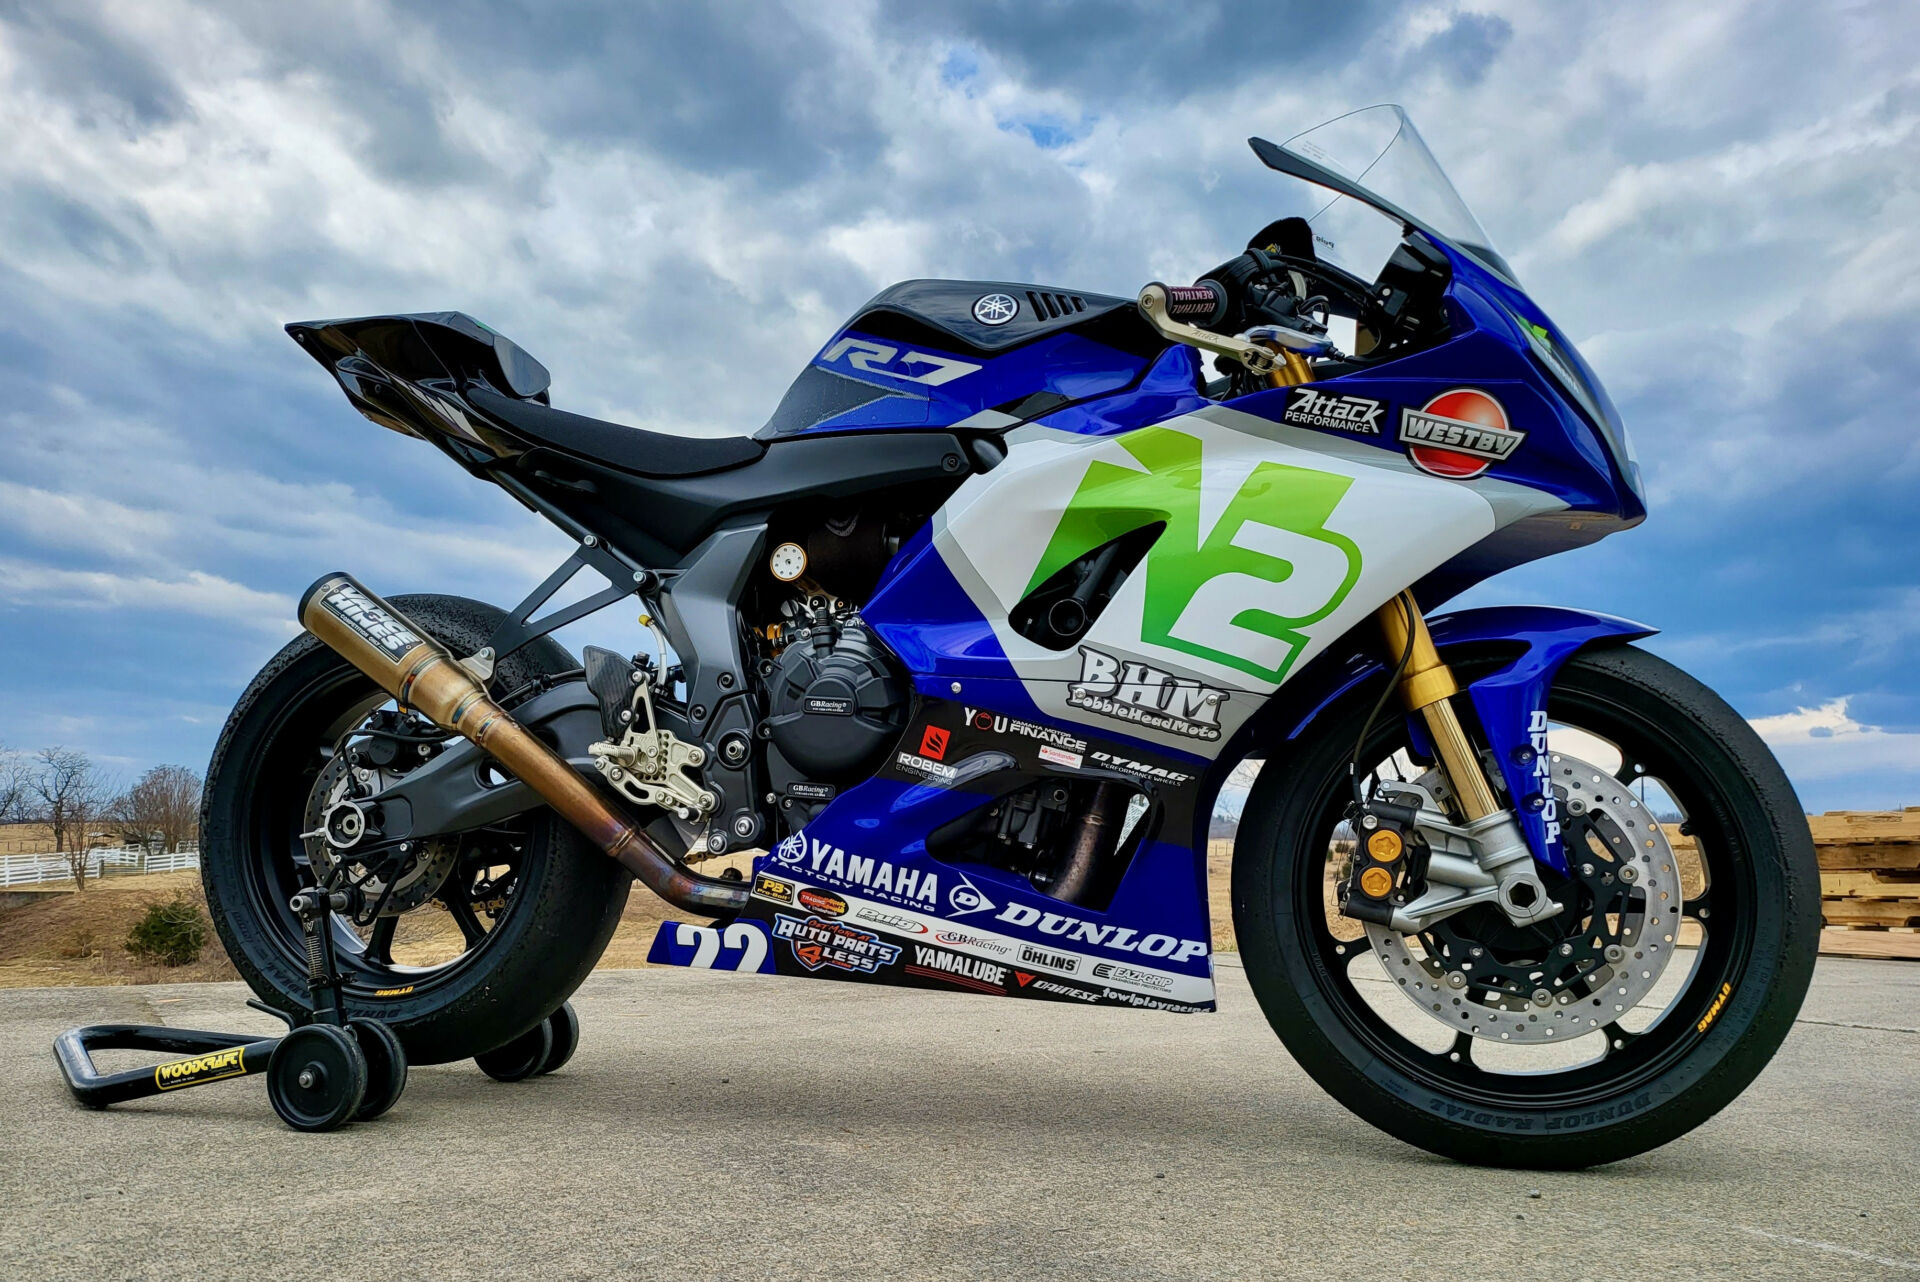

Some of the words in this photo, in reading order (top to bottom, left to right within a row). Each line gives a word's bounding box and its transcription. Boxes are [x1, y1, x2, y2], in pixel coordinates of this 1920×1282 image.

[1172, 290, 1214, 301] RENTHAL
[1172, 302, 1215, 314] RENTHAL
[822, 337, 983, 386] R7
[1285, 411, 1371, 433] PERFORMANCE
[1288, 388, 1384, 433] Attack
[1407, 417, 1514, 454] WESTBY
[327, 593, 405, 651] HINES
[340, 614, 369, 638] COMPETITION
[1071, 646, 1228, 725] BHM
[1009, 723, 1088, 751] FINANCE
[1012, 719, 1043, 731] YAMAHA
[1044, 727, 1072, 738] MOTOR
[895, 764, 953, 785] ENGINEERING
[900, 753, 956, 779] ROBEM
[1090, 751, 1189, 782] DYMAG
[1101, 762, 1152, 780] PERFORMANCE
[1153, 776, 1181, 787] WHEELS
[1528, 711, 1560, 844] DUNLOP
[770, 856, 853, 888] FACTORY
[863, 888, 936, 912] RACING
[811, 838, 938, 904] YAMAHA
[856, 907, 915, 931] Puig
[994, 901, 1208, 963] DUNLOP
[676, 923, 768, 974] 22
[777, 919, 831, 944] AUTO
[832, 933, 894, 961] PARTS
[798, 945, 822, 964] 4
[822, 947, 875, 970] LESS
[914, 944, 1007, 986] YAMALUBE
[1021, 946, 1077, 971] ÖHLINS
[1114, 967, 1173, 988] EAZI-GRIP
[1697, 982, 1731, 1033] DYMAG
[161, 1051, 239, 1080] WOODCRAFT
[1429, 1097, 1534, 1130] RADIAL
[1545, 1091, 1652, 1130] DUNLOP
